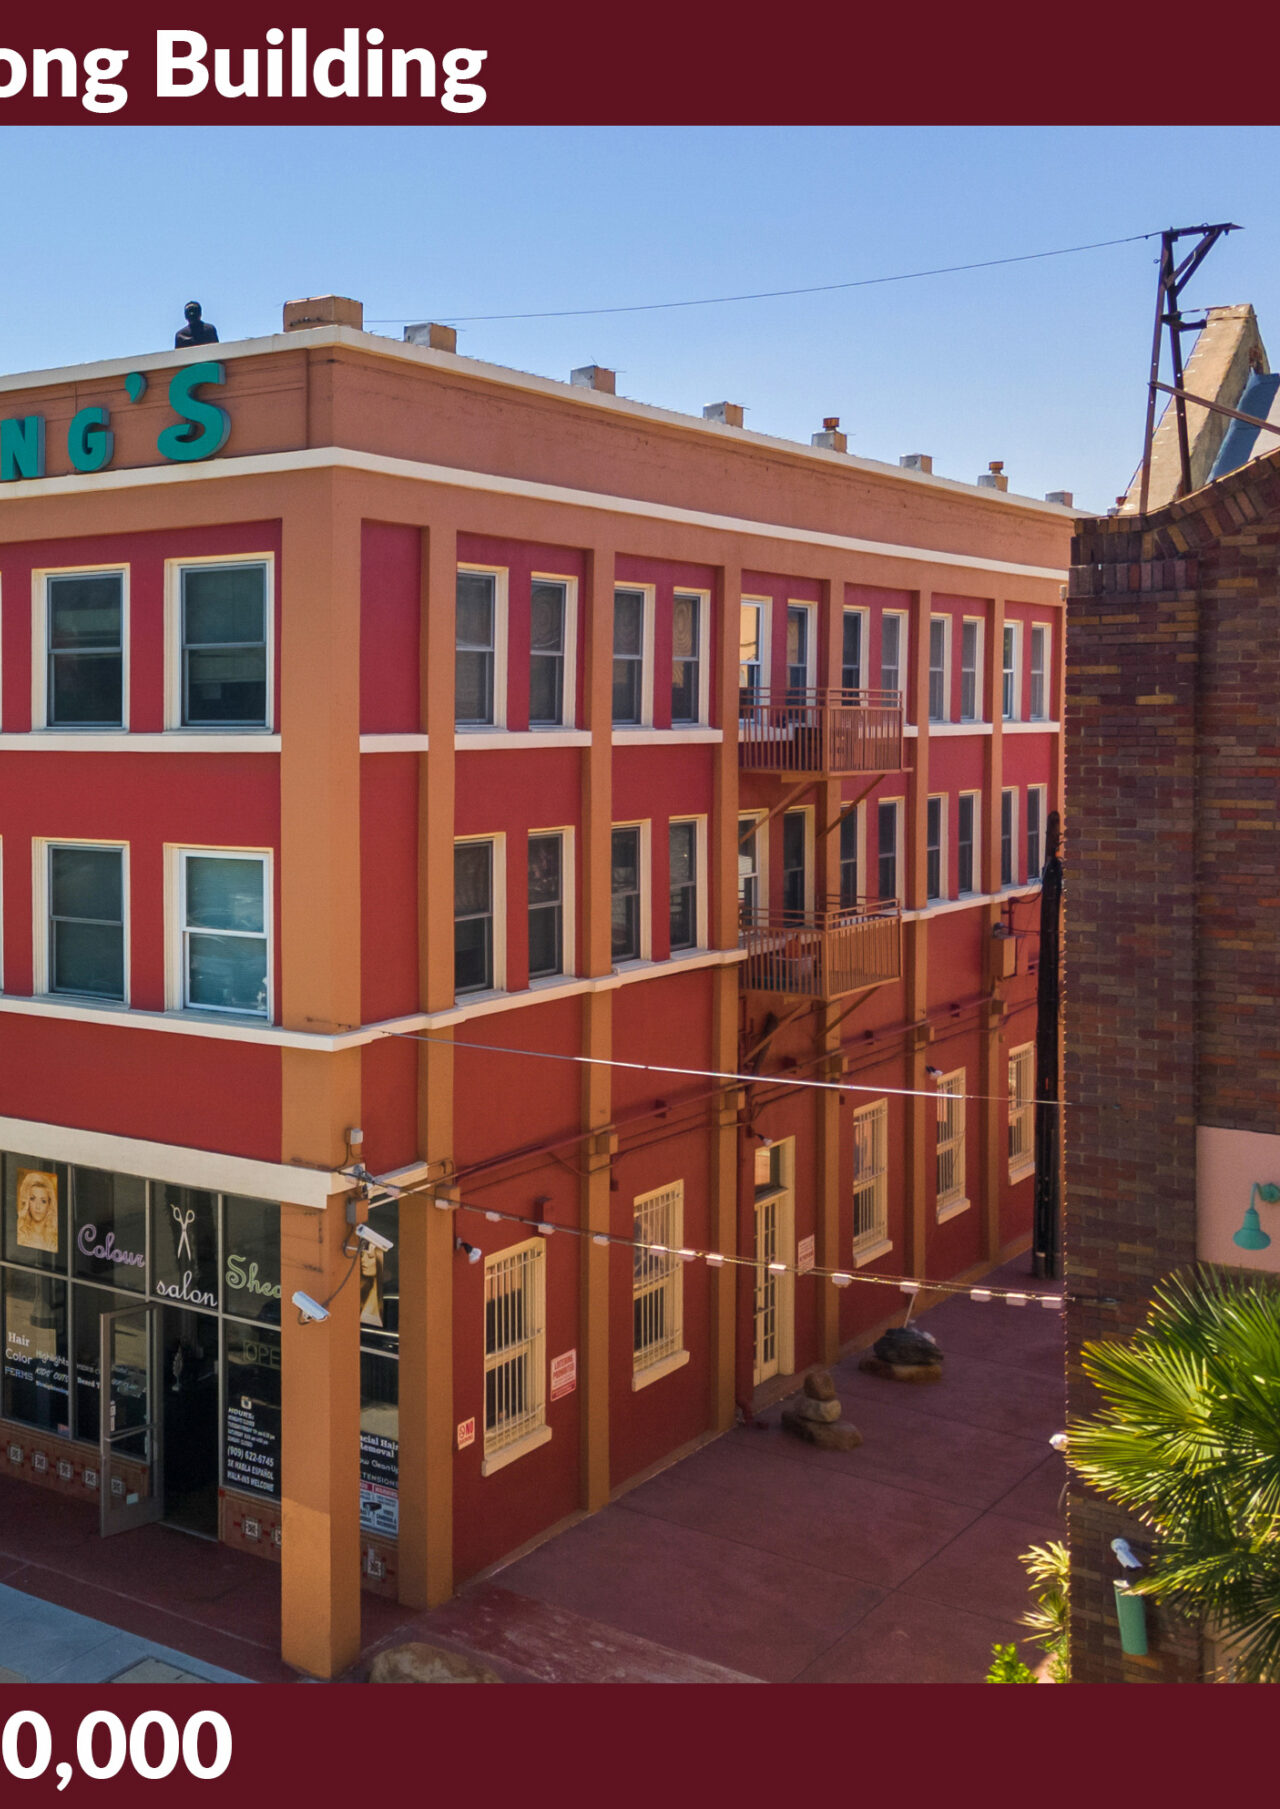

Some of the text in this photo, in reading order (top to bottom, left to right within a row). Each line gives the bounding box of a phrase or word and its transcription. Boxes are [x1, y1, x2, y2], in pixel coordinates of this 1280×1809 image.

[78, 1223, 145, 1268] Colour
[156, 1270, 218, 1307] salon
[7, 1331, 30, 1347] Hair
[5, 1347, 33, 1365] Color
[246, 1343, 281, 1369] OPE
[4, 1365, 34, 1381] PERMS
[465, 1421, 474, 1435] NO
[360, 1434, 398, 1450] acial Hair
[228, 1445, 244, 1460] (909)
[360, 1471, 398, 1487] TENSION
